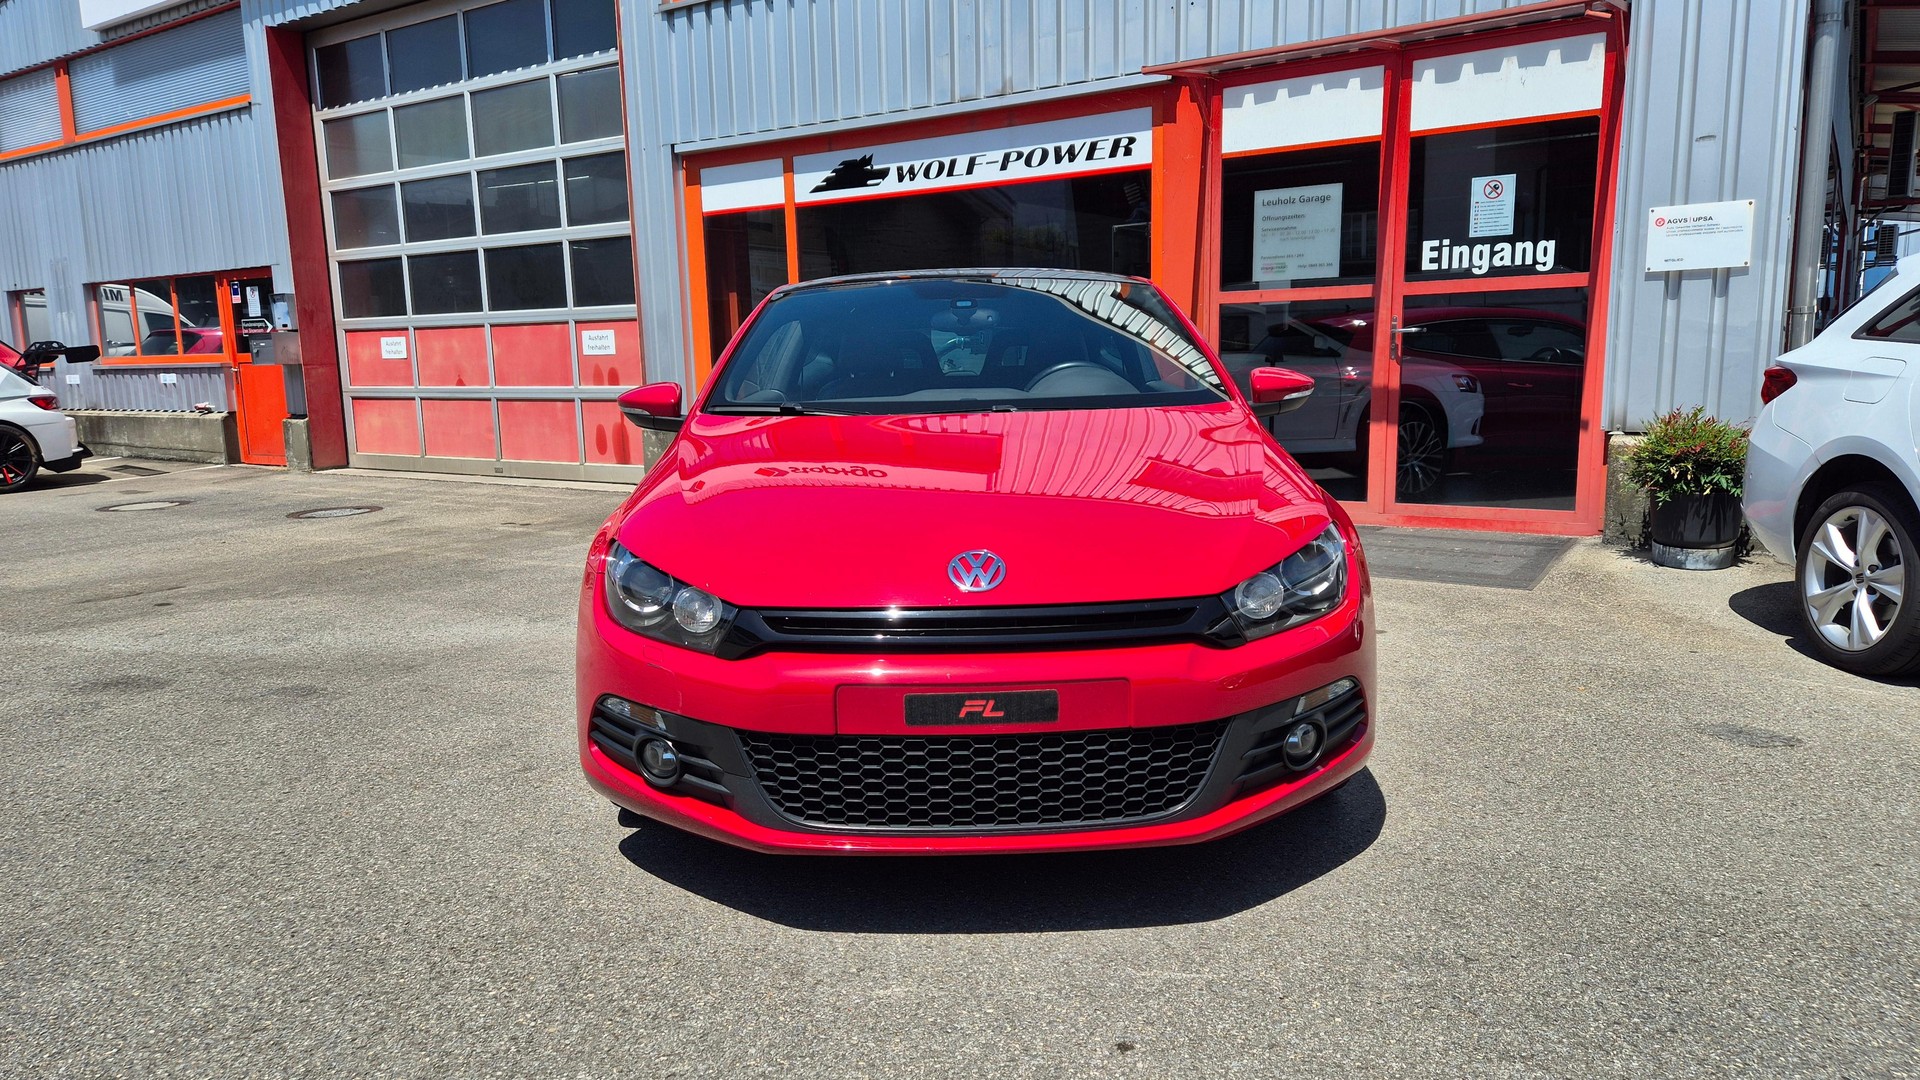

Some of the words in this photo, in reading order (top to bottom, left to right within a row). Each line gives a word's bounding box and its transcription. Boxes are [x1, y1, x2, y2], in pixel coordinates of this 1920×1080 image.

[895, 135, 1138, 184] WOLF-POWER
[1262, 196, 1296, 207] Leuholz
[1298, 194, 1332, 204] Garage
[1421, 238, 1556, 275] Eingang
[948, 549, 1006, 592] VW
[959, 700, 1004, 718] FL
